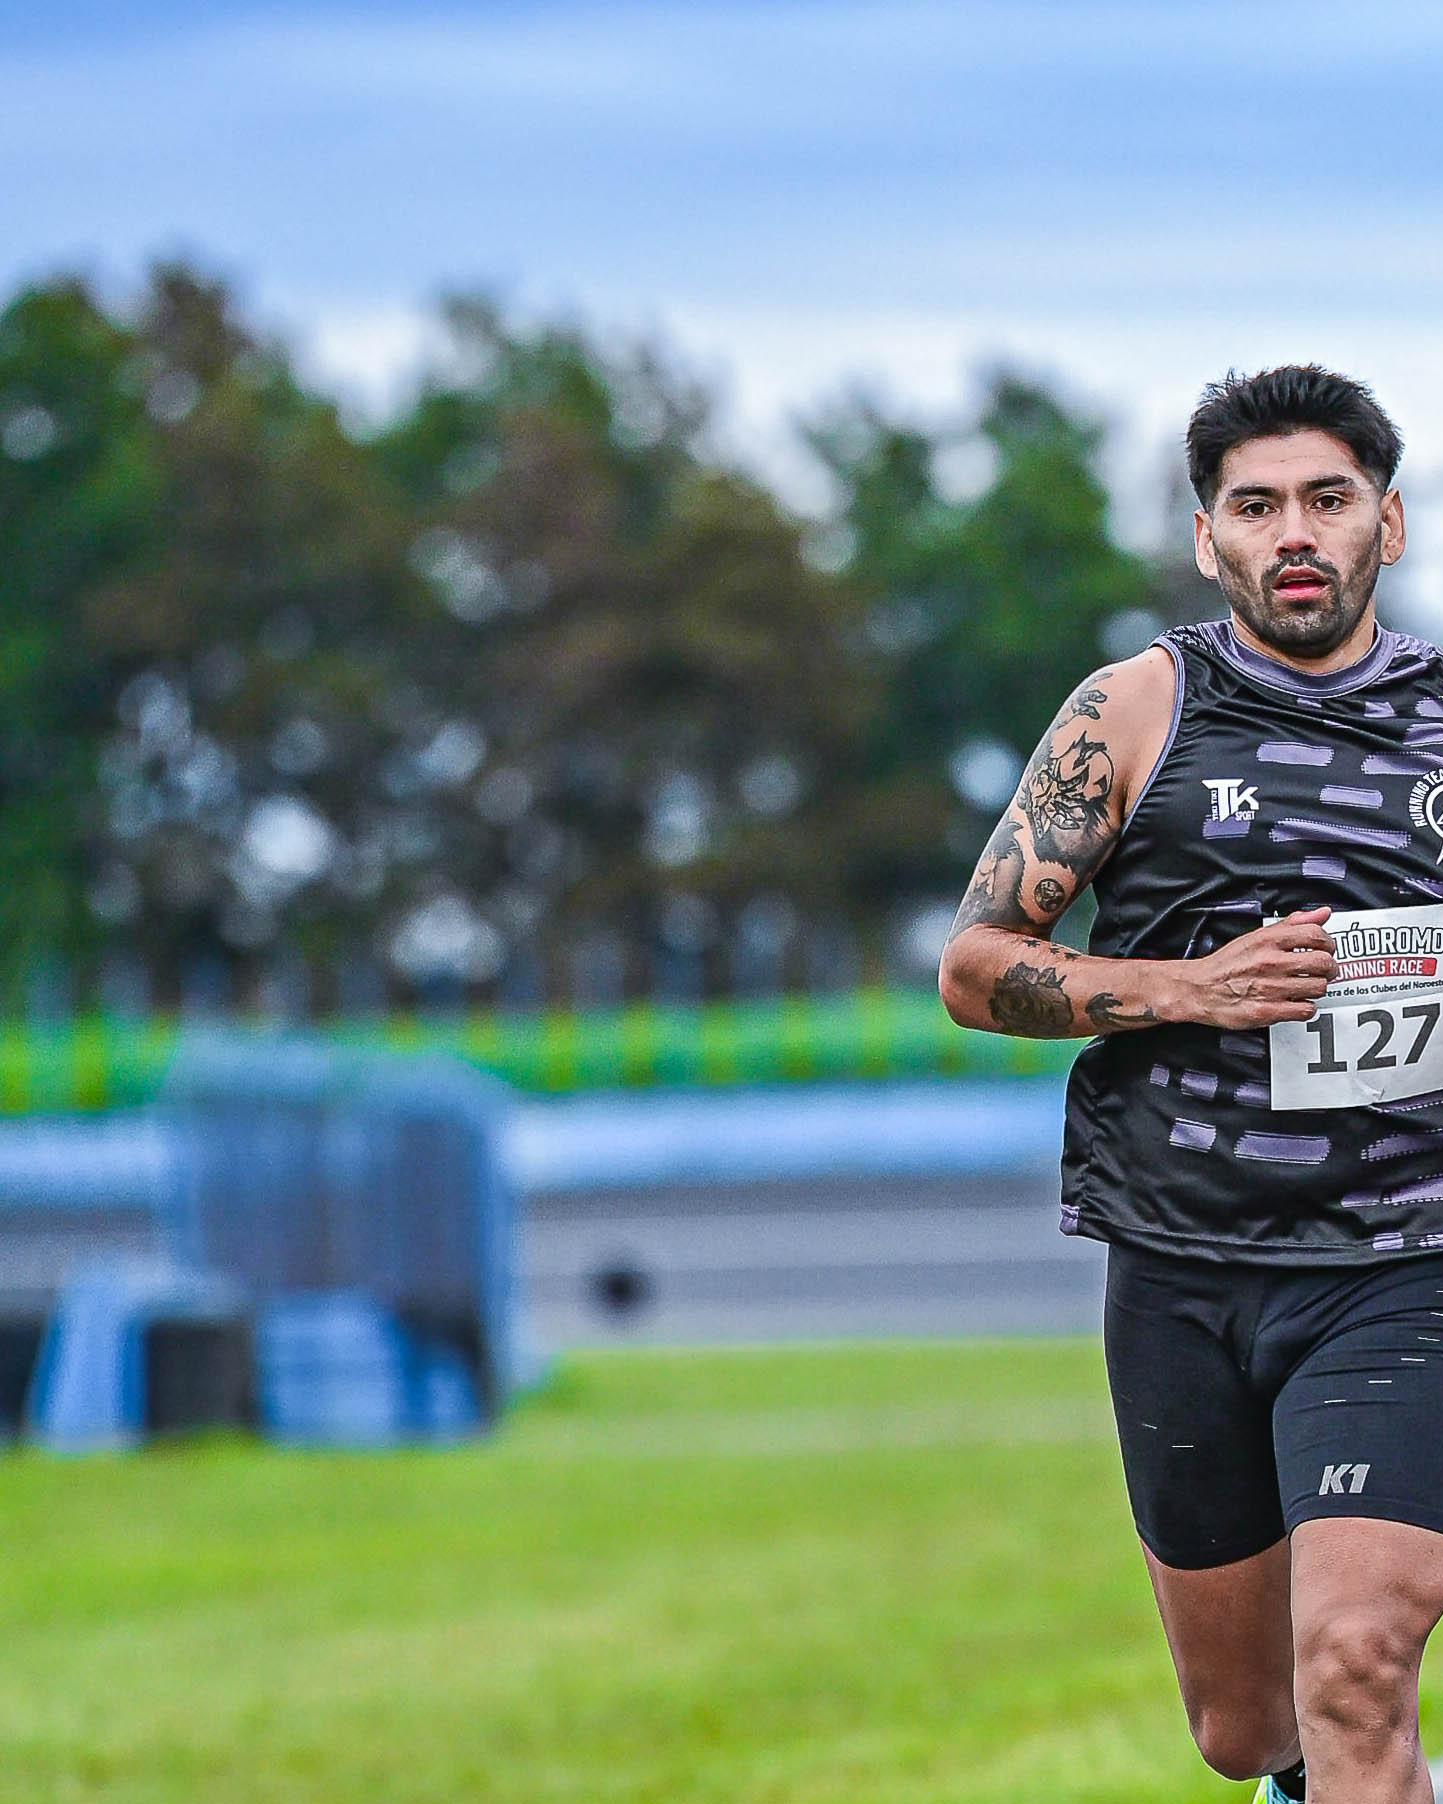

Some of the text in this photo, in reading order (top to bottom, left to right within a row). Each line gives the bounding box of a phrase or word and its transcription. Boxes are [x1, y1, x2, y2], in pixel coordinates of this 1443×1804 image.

[1202, 779, 1259, 822] TK
[1235, 811, 1255, 821] SPORT
[1409, 781, 1429, 827] RUNNING
[1337, 960, 1423, 980] UNNING RACE
[1325, 989, 1341, 998] rera
[1343, 987, 1356, 996] de
[1356, 986, 1369, 995] los
[1371, 982, 1397, 994] Clubes
[1399, 981, 1411, 991] del
[1307, 1003, 1440, 1073] 127
[1318, 1463, 1371, 1496] K1
